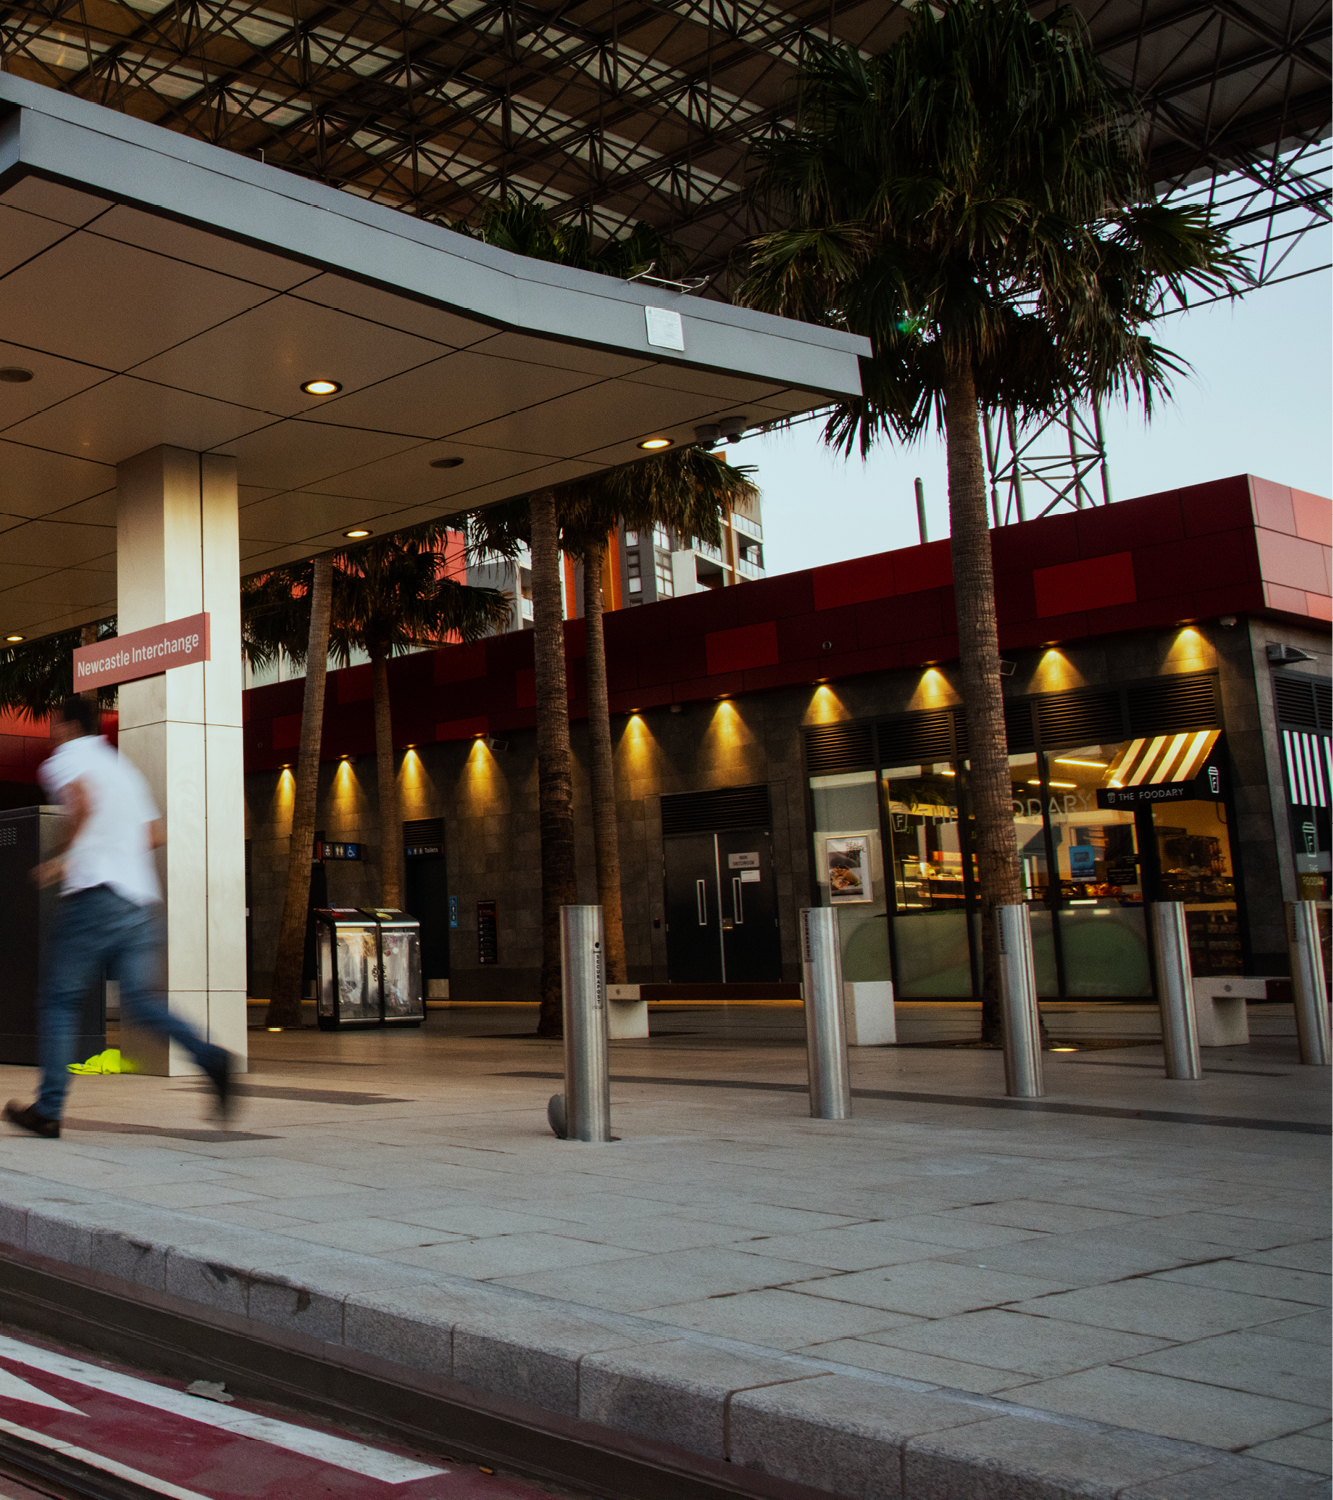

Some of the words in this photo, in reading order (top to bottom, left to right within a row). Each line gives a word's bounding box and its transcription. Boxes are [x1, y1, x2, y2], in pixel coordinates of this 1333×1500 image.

[77, 650, 130, 678] Newcastle
[132, 633, 200, 664] Interchange
[1012, 793, 1092, 819] ODARY
[1118, 792, 1135, 801] THE
[1139, 788, 1184, 800] FOODARY
